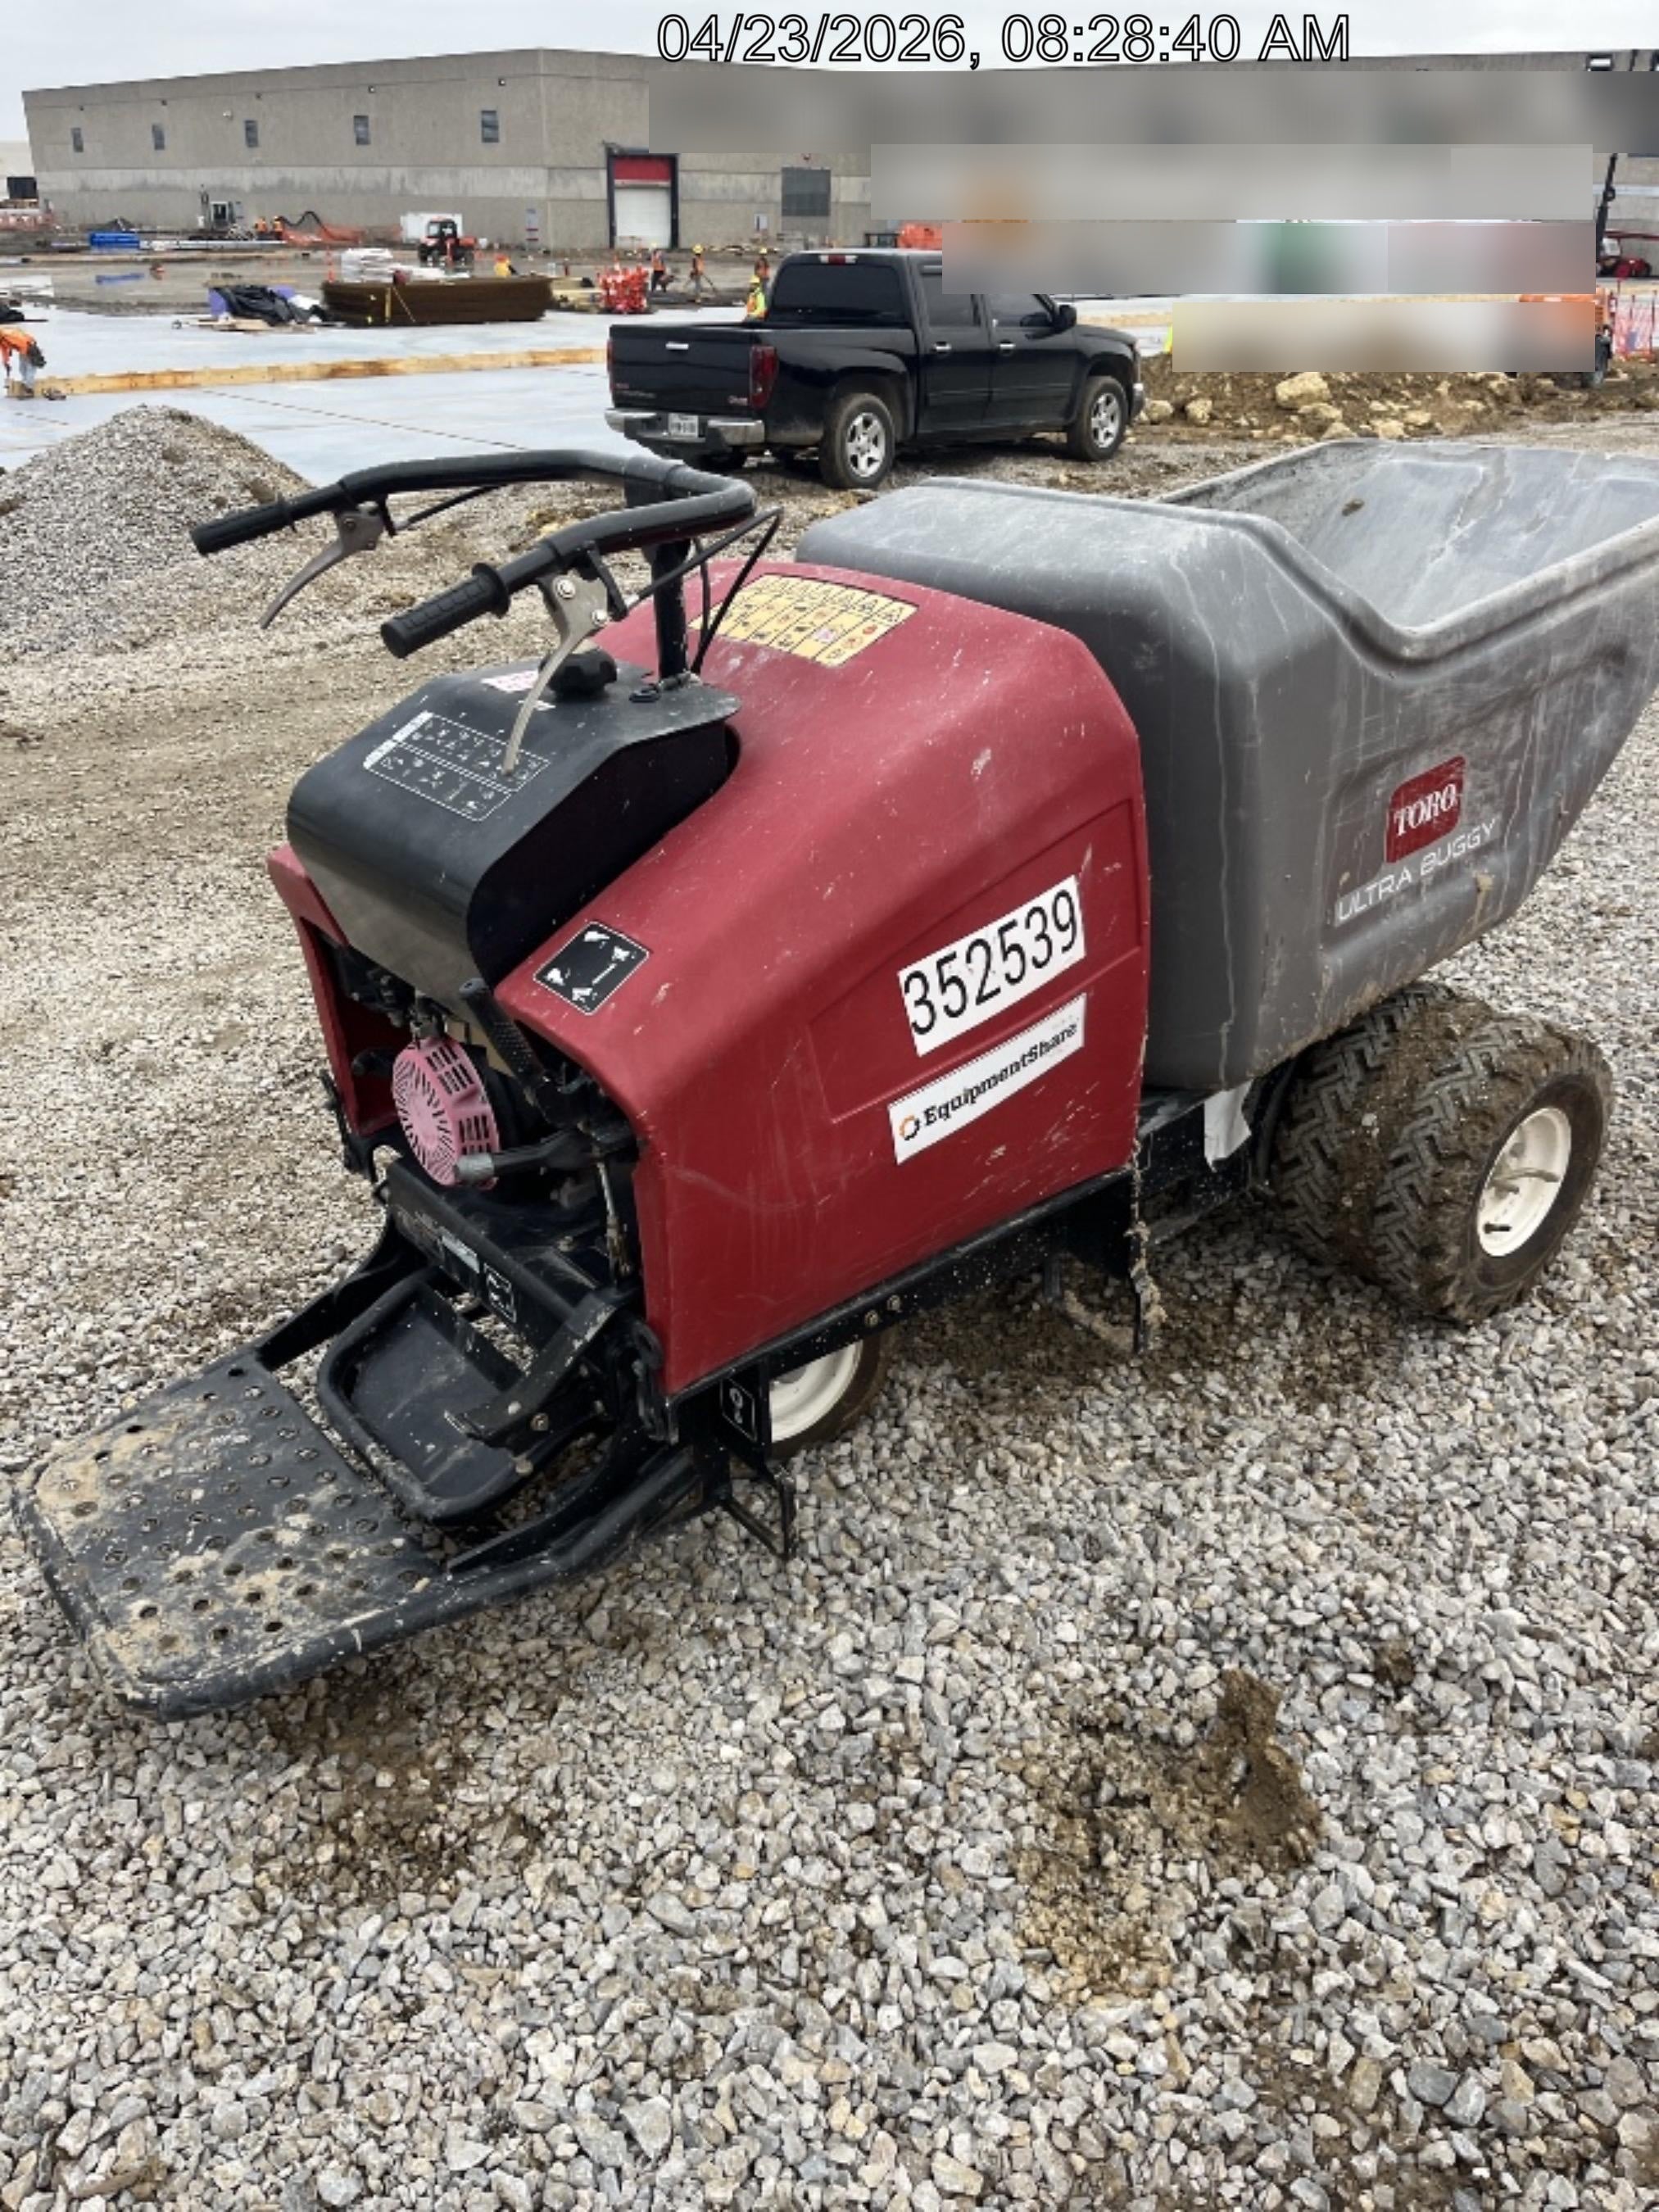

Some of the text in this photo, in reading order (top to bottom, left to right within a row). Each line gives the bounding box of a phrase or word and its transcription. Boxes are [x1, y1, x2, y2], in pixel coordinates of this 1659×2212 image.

[1393, 783, 1457, 836] TORO
[1338, 818, 1496, 921] ULTRA BUGGY
[904, 890, 1078, 1036] 352539
[923, 1023, 1078, 1127] EquipmentShare
